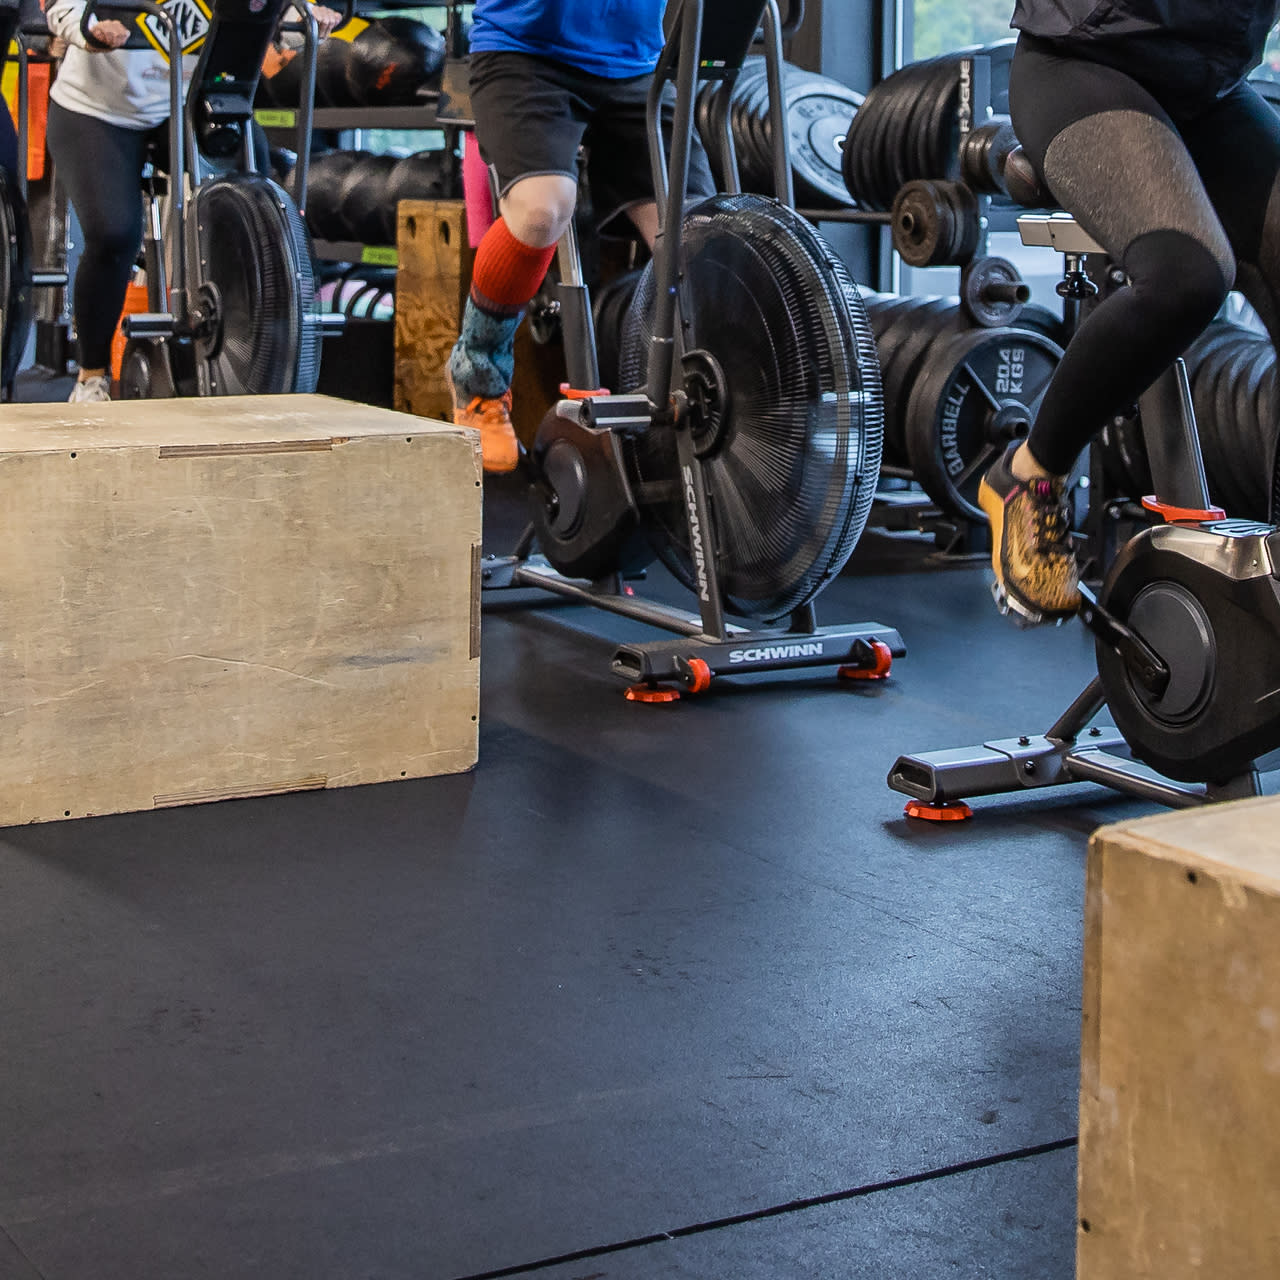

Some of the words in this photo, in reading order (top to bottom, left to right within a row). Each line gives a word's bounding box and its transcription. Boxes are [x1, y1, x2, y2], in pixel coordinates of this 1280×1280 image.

[1010, 348, 1025, 394] KGS
[942, 383, 971, 477] BARBELL
[683, 464, 709, 602] SCHWINN
[728, 643, 824, 664] SCHWINN
